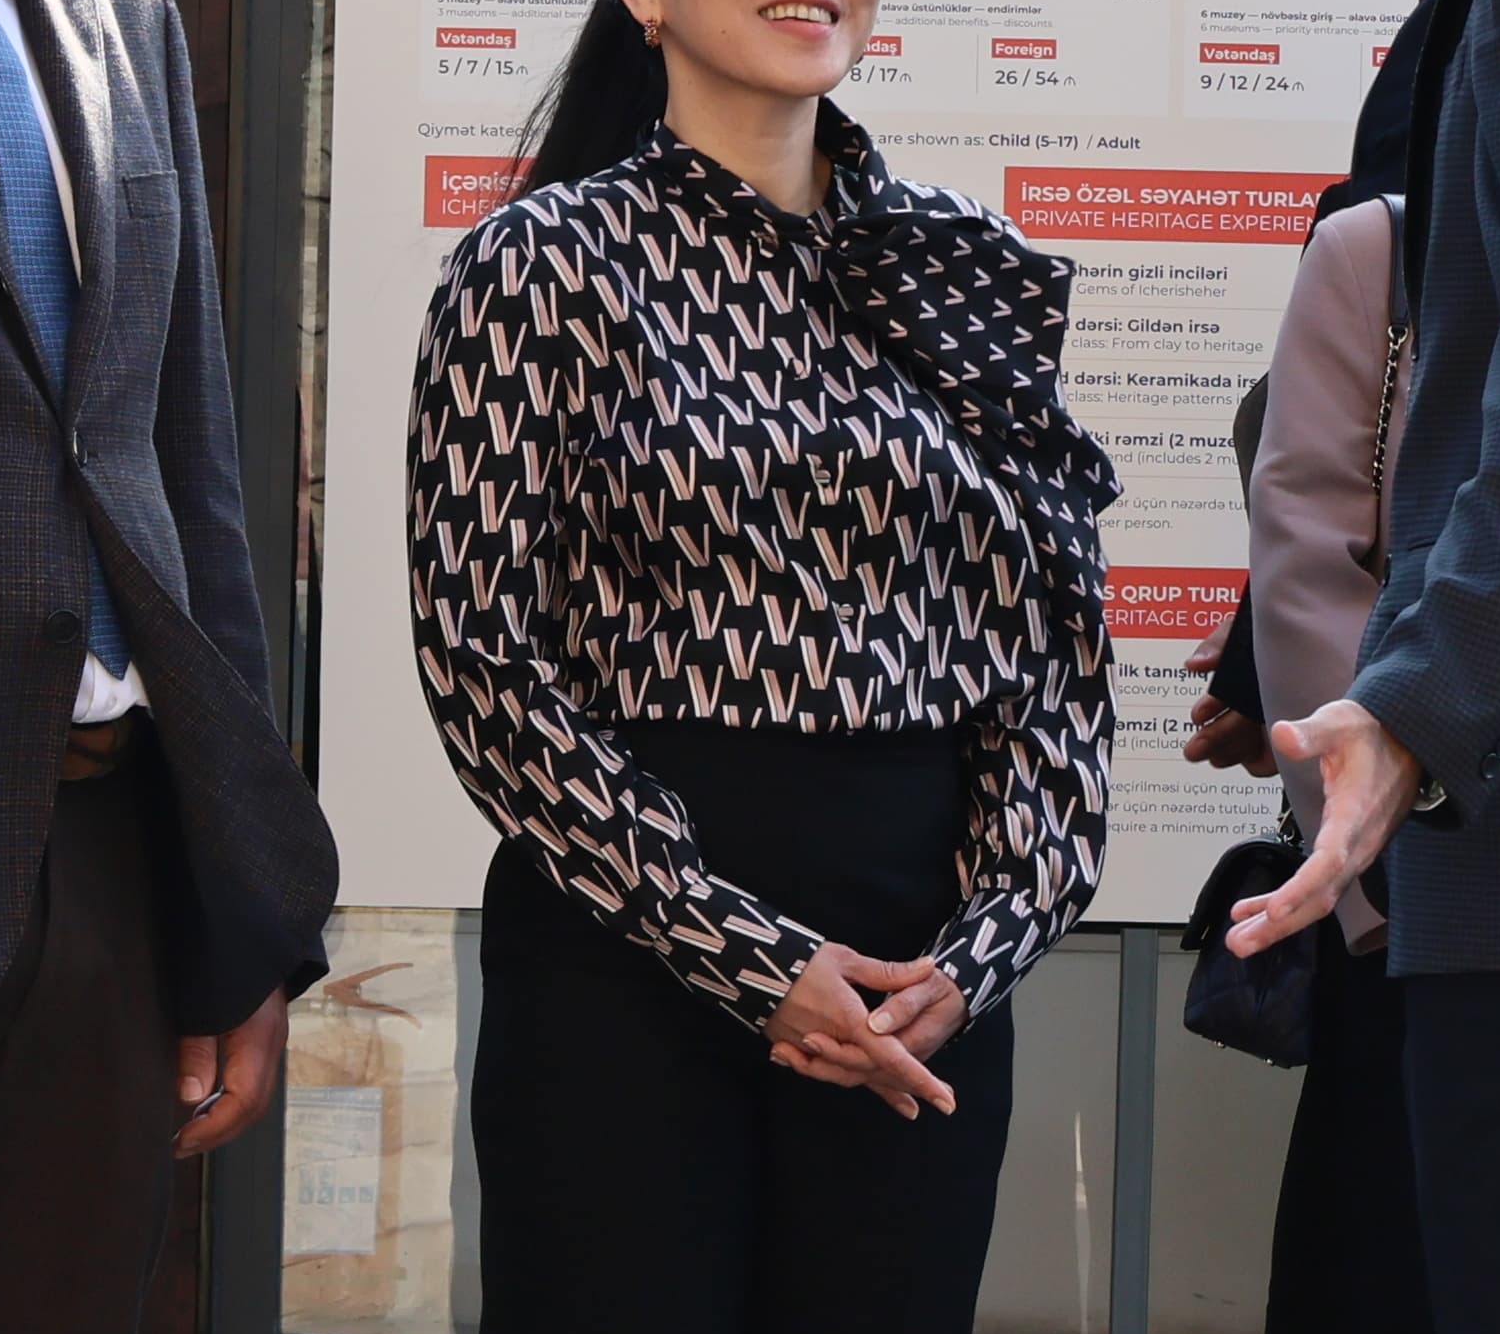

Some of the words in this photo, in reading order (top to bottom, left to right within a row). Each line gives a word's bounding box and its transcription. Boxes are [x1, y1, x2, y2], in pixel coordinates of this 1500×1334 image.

[441, 33, 512, 48] Vətəndaş
[996, 43, 1052, 58] Foreign
[1204, 49, 1275, 63] Vətəndaş
[418, 123, 476, 138] Qiymət
[879, 135, 903, 144] are
[908, 133, 959, 145] shown
[965, 137, 984, 146] as:
[989, 134, 1030, 147] Child
[1097, 137, 1140, 149] Adult
[1022, 182, 1070, 202] İRSƏ
[1077, 183, 1134, 203] ÖZƏL
[1140, 189, 1240, 206] SƏYAHƏT
[1022, 210, 1104, 227] PRIVATE
[1112, 211, 1213, 229] HERITAGE
[1129, 265, 1163, 281] gizli
[1170, 265, 1227, 280] inciləri
[1076, 283, 1117, 295] Gems
[1121, 284, 1136, 295] of
[1139, 284, 1227, 297] Icherisheher
[1075, 318, 1122, 331] dərsi:
[1128, 318, 1183, 333] Gildən
[1189, 319, 1220, 333] irsə
[1071, 336, 1108, 348] class:
[1112, 337, 1150, 349] From
[1153, 339, 1181, 353] clay
[1185, 340, 1200, 350] to
[1204, 339, 1263, 354] heritage
[1075, 372, 1121, 385] dərsi:
[1127, 373, 1231, 387] Keramikada
[1066, 390, 1103, 403] class:
[1108, 391, 1168, 406] Heritage
[1173, 394, 1232, 406] patterns
[1097, 519, 1121, 532] per
[1125, 520, 1173, 531] person.
[1121, 586, 1182, 604] QRUP
